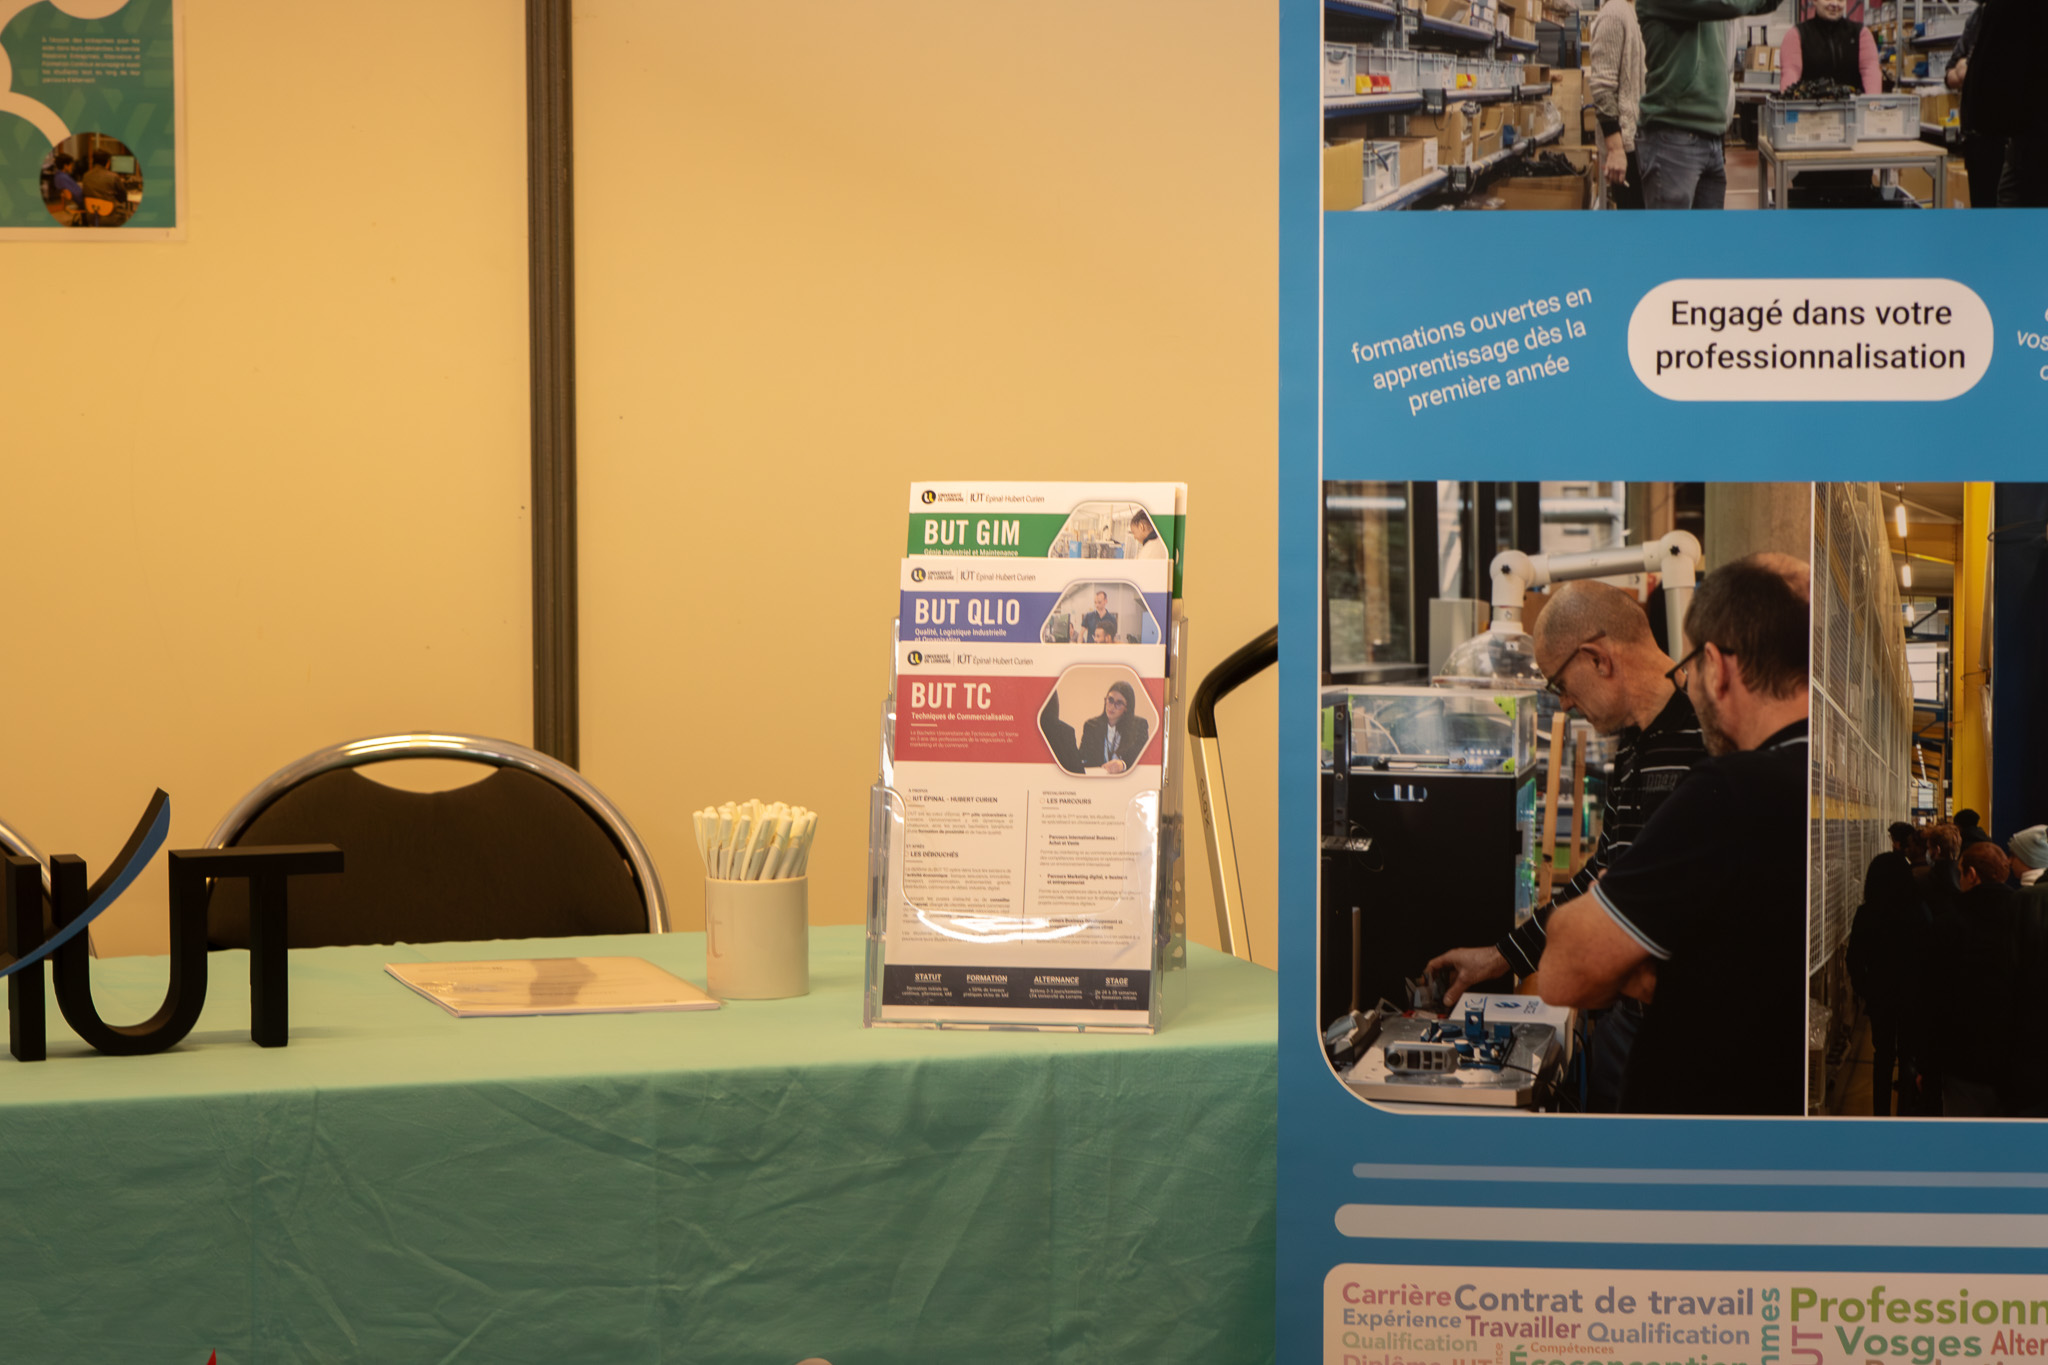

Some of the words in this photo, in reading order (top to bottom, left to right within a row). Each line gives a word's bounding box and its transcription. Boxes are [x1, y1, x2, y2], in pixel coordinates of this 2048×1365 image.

[1351, 321, 1466, 364] formations
[1470, 296, 1561, 333] ouvertes
[1566, 288, 1592, 308] en
[1671, 299, 1783, 332] Engagé
[1792, 300, 1866, 325] dans
[1876, 302, 1952, 325] votre
[1373, 338, 1520, 391] apprentissage
[1524, 326, 1562, 350] dès
[1566, 318, 1586, 339] la
[1656, 343, 1966, 376] professionnalisation
[1409, 373, 1501, 416] première
[1506, 354, 1570, 386] année
[970, 493, 985, 502] IUT
[1005, 495, 1024, 503] Hubert
[1026, 495, 1045, 503] Curien
[924, 520, 969, 545] BUT
[976, 519, 1020, 546] GIM
[924, 548, 941, 556] Génie
[943, 548, 971, 556] Industriel
[980, 549, 1019, 557] Maintenance
[960, 571, 974, 580] IUT
[915, 599, 959, 624] BUT
[968, 599, 1020, 626] QLIO
[915, 628, 938, 637] Qualité,
[940, 629, 971, 637] Logistique
[957, 654, 972, 664] IUT
[973, 656, 991, 665] Épinal
[993, 657, 1013, 665] Hubert
[1014, 657, 1033, 665] Curien
[911, 682, 956, 709] BUT
[964, 683, 991, 710] TC
[911, 712, 946, 721] Techniques
[957, 713, 1014, 721] Commercialisation
[5, 843, 345, 1062] IUT
[915, 973, 942, 981] STATUT
[967, 974, 1007, 982] FORMATION
[1034, 976, 1079, 984] ALTERNANCE
[1105, 977, 1128, 985] STAGE
[1342, 1282, 1452, 1307] Carrière
[1454, 1284, 1583, 1313] Contrat
[1595, 1286, 1637, 1314] de
[1648, 1287, 1753, 1315] travail
[1343, 1308, 1462, 1331] Expérience
[1465, 1315, 1581, 1338] Travailler
[1587, 1321, 1750, 1345] Qualification
[1342, 1331, 1477, 1351] Qualification
[1530, 1342, 1614, 1356] Compétences
[1834, 1326, 1982, 1365] Vosges
